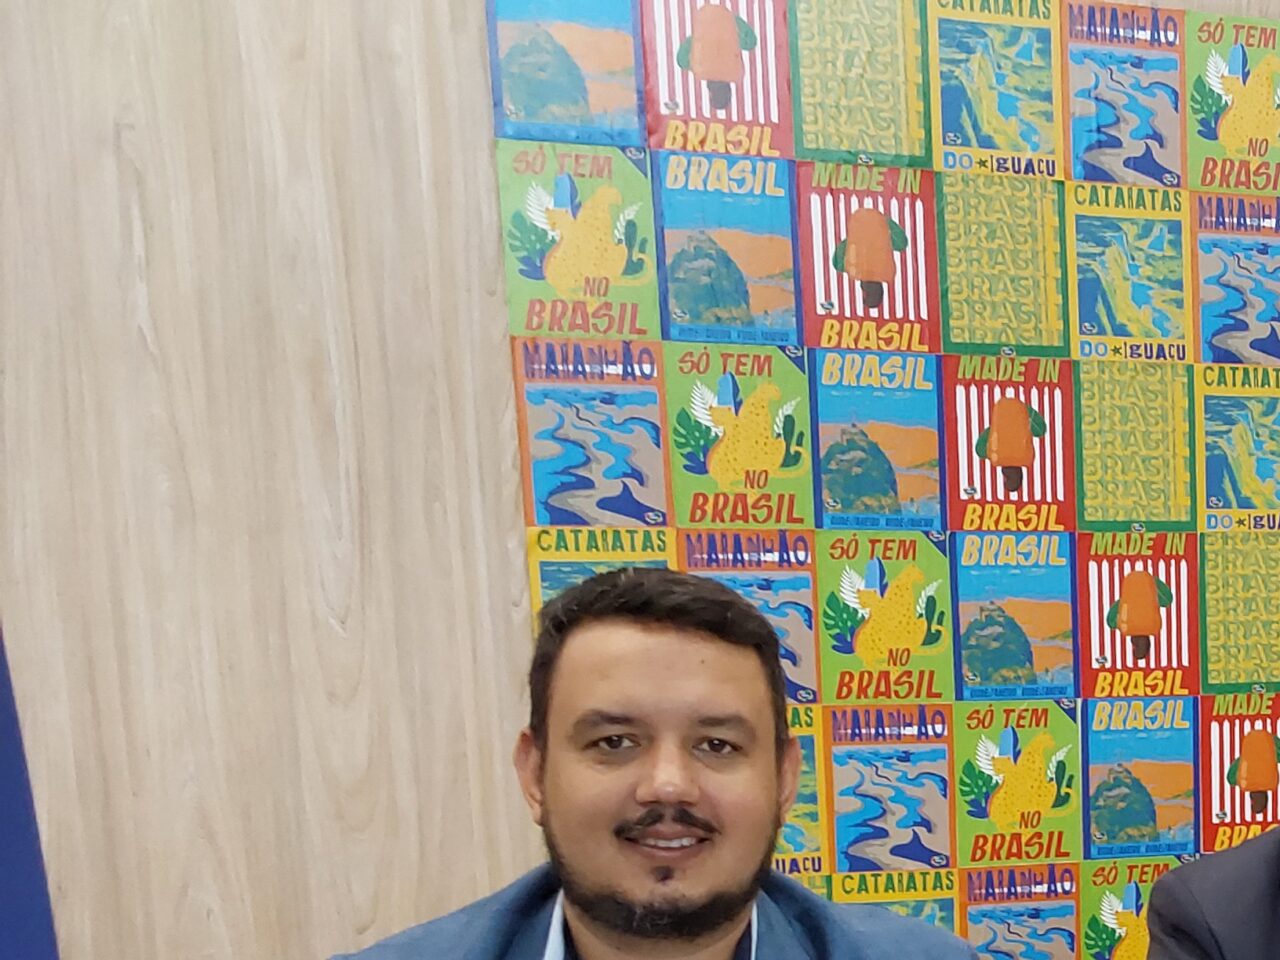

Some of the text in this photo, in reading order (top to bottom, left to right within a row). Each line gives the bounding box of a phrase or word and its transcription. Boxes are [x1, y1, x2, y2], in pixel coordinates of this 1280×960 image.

[1197, 17, 1277, 50] SÓ TEM
[664, 120, 780, 157] BRASIL
[1248, 138, 1268, 157] NO
[513, 145, 613, 179] SÓ TEM
[943, 152, 974, 170] DO
[666, 156, 785, 197] BRASIL
[812, 161, 921, 194] MADE IN
[583, 276, 610, 297] NO
[526, 300, 648, 336] BRASIL
[820, 319, 929, 352] BRASIL
[1079, 341, 1108, 357] DO
[678, 346, 773, 377] SÓ TEM
[821, 353, 933, 391] BRASIL
[957, 355, 1061, 383] MADE IN
[744, 469, 768, 489] NO
[689, 493, 805, 525] BRASIL
[963, 504, 1065, 532] BRASIL
[1206, 514, 1233, 530] DO
[829, 533, 917, 562] SÓ TEM
[960, 534, 1067, 566] BRASIL
[1090, 532, 1186, 556] MADE IN
[887, 647, 911, 667] NO
[836, 669, 943, 700] BRASIL
[1094, 669, 1190, 698] BRASIL
[966, 704, 1049, 731] SÓ TEM
[1092, 700, 1190, 731] BRASIL
[1212, 693, 1275, 716] MADE
[1018, 810, 1041, 829] NO
[970, 831, 1071, 862] BRASIL
[1091, 861, 1170, 887] SÓ TEM
